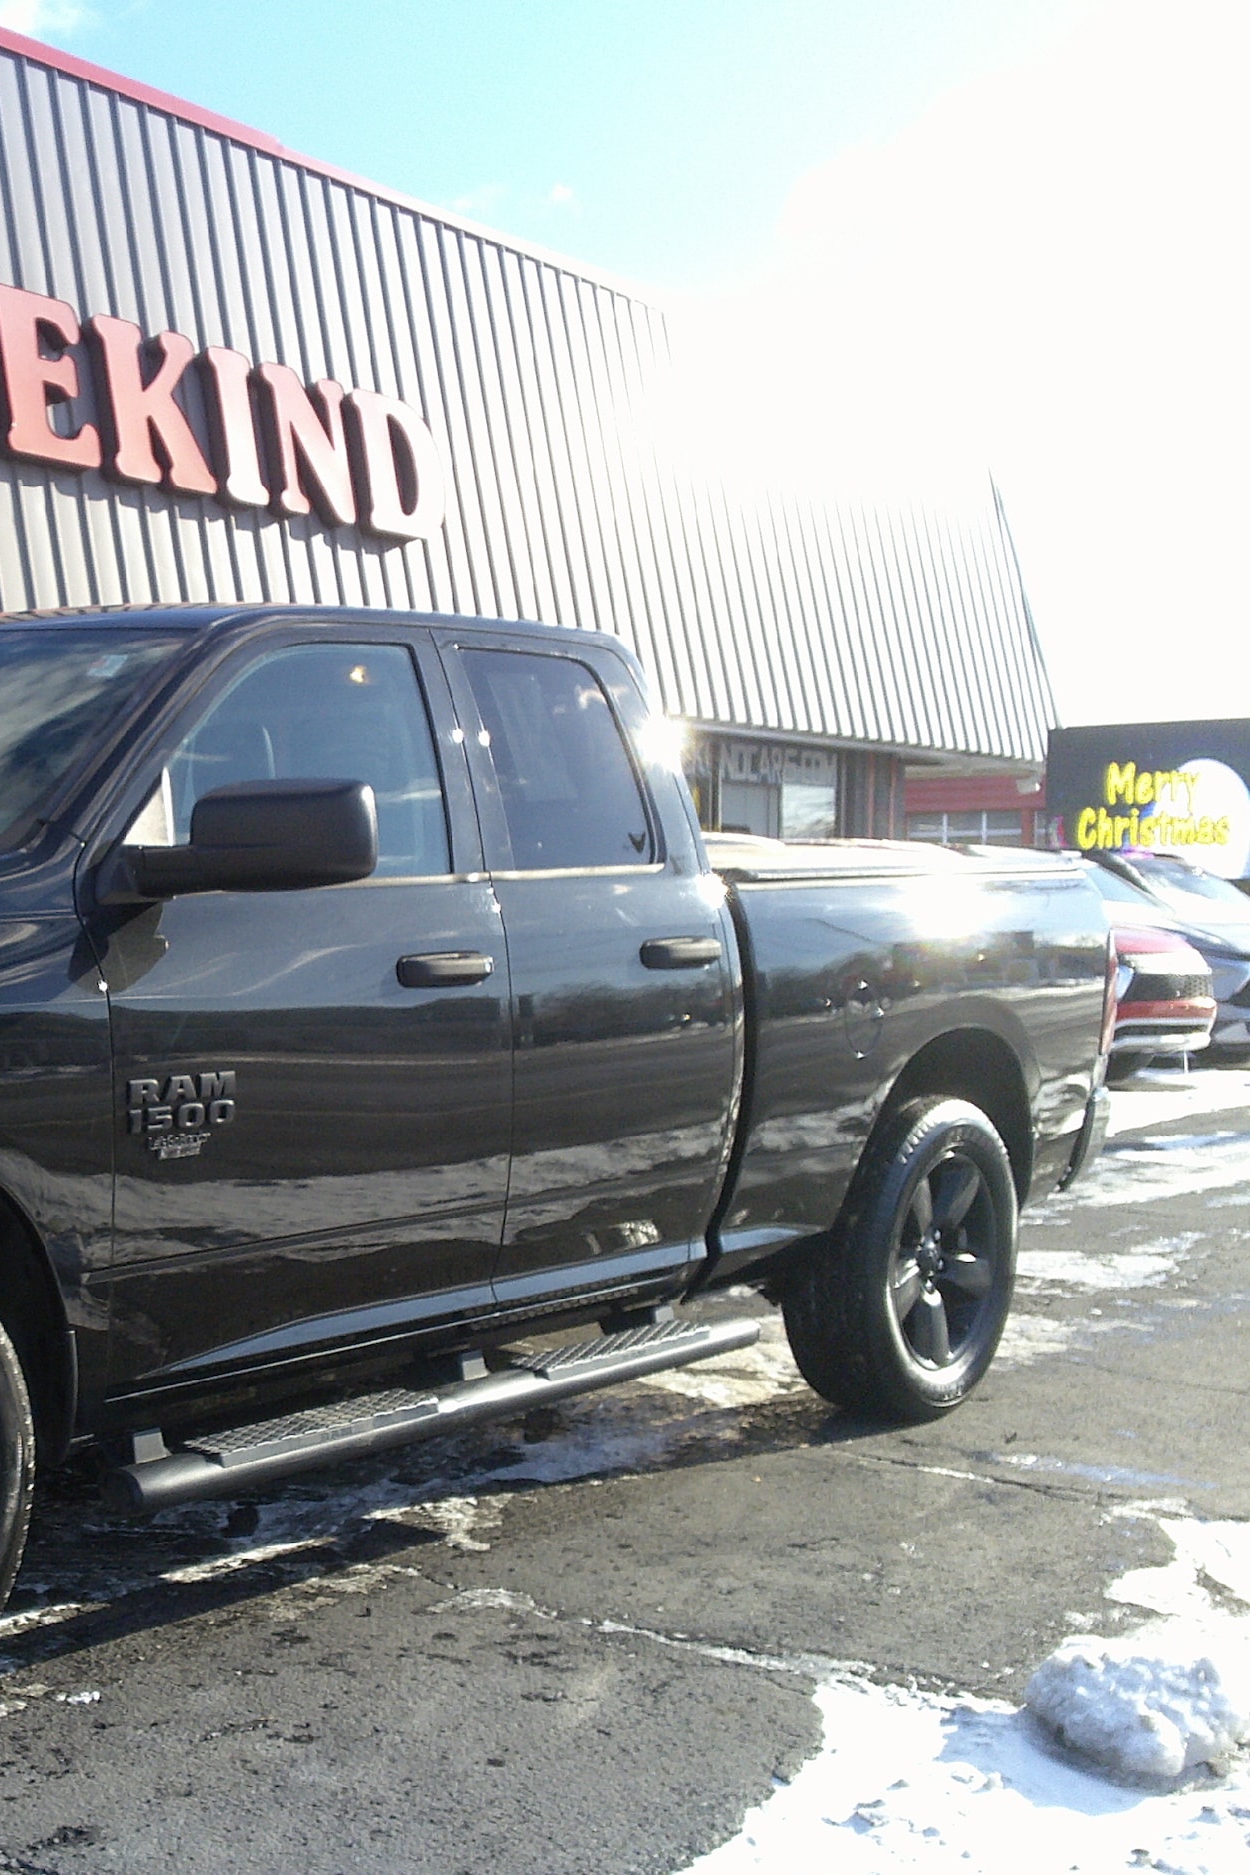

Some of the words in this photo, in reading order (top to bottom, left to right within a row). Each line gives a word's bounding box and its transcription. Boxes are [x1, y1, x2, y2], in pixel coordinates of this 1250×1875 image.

[1104, 761, 1201, 812] Merry
[1076, 806, 1231, 852] Christmas
[127, 1070, 236, 1104] RAM
[127, 1099, 236, 1133] 1500
